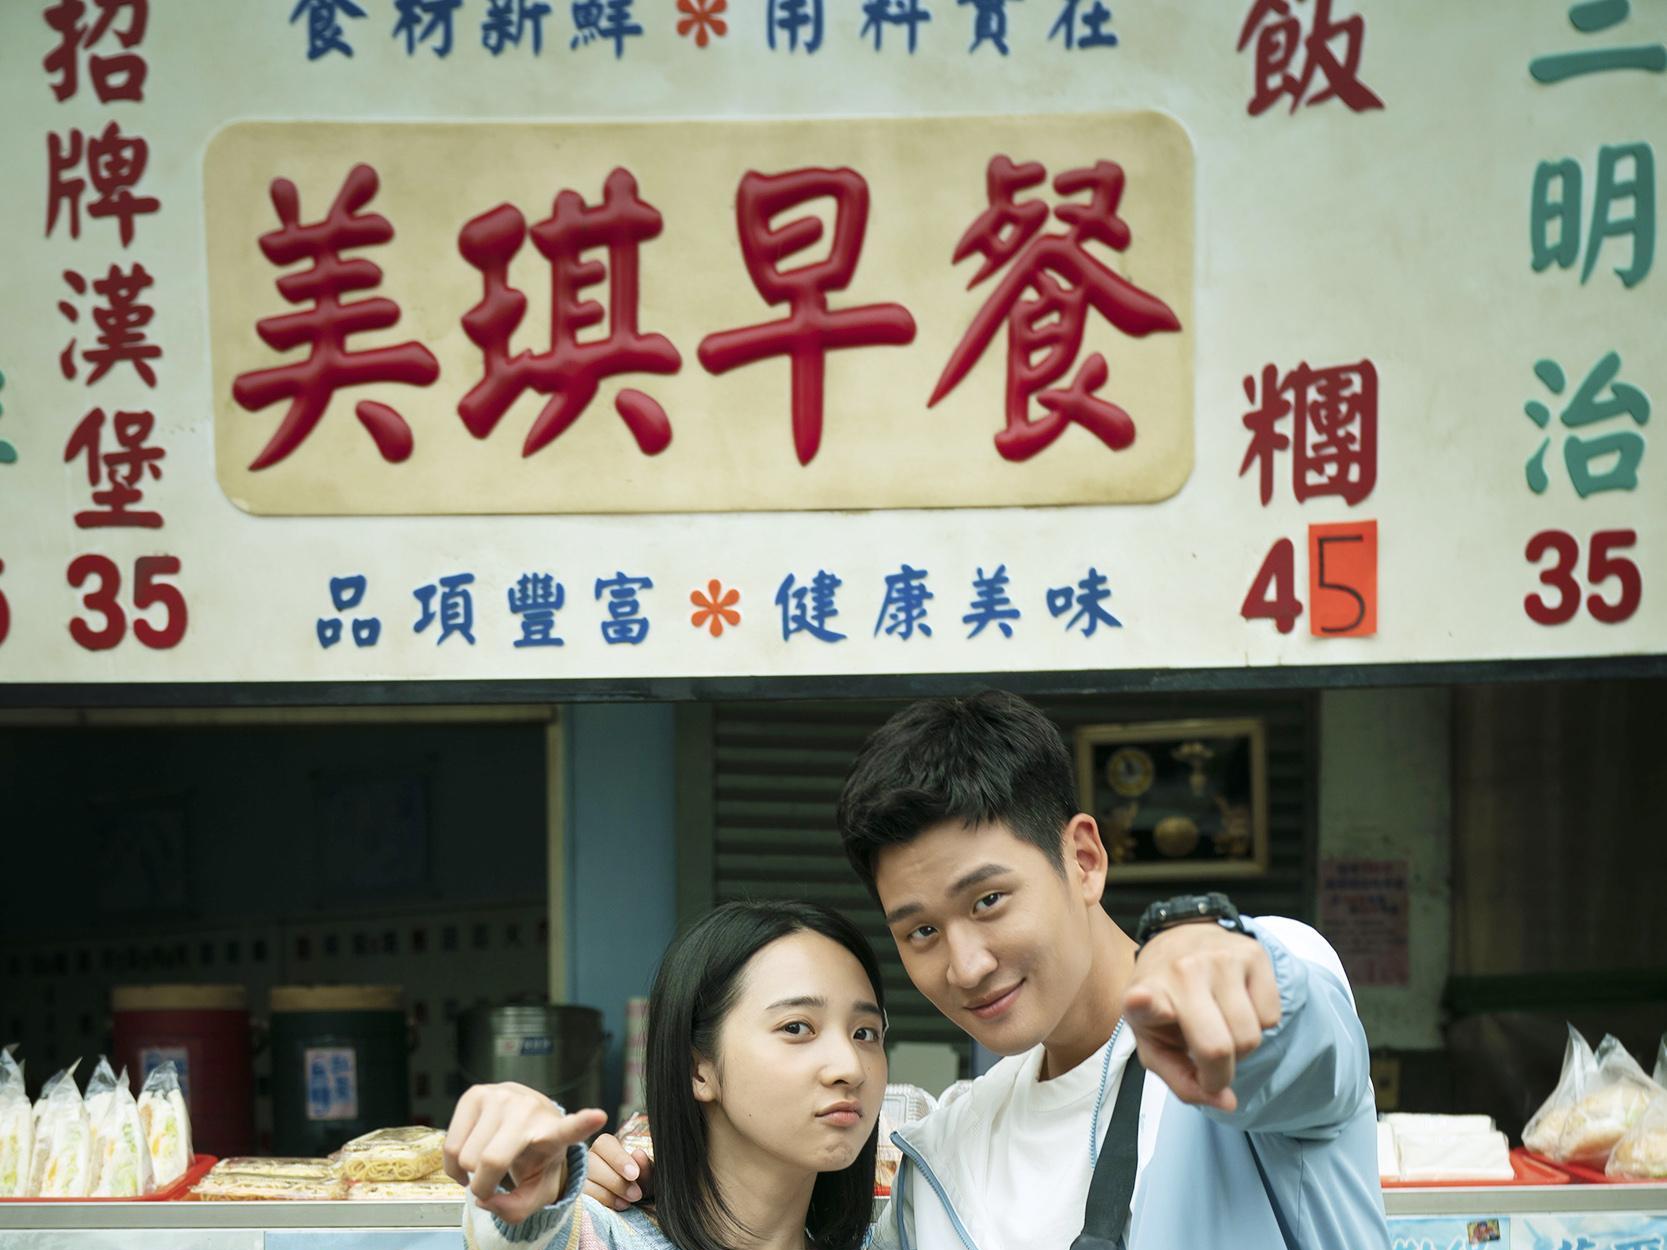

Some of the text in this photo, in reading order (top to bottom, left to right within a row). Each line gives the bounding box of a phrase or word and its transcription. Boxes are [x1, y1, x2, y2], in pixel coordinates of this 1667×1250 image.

[290, 0, 644, 60] 食材新鮮
[43, 0, 166, 530] 招牌漢堡
[231, 155, 1183, 472] 美琪早餐
[66, 553, 188, 651] 35
[314, 570, 655, 649] 品項豐富
[774, 563, 1123, 644] 健康美味
[1523, 529, 1642, 626] 35
